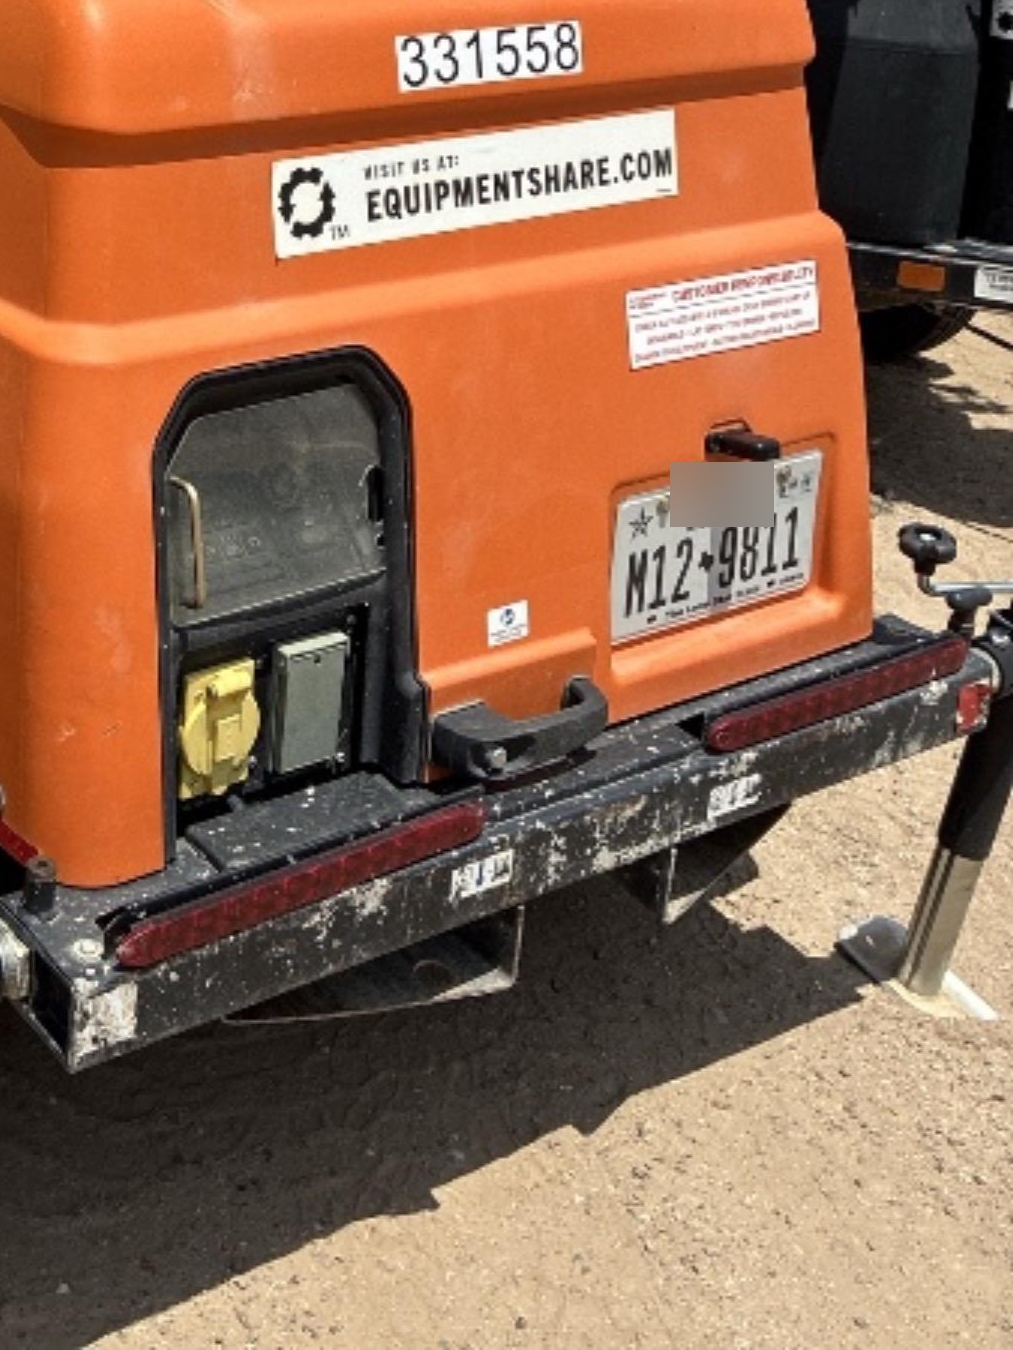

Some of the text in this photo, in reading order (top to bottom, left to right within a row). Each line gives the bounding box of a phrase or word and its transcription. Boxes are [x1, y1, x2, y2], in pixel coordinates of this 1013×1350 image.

[400, 23, 579, 88] 331558
[364, 154, 460, 181] VISIT US AT:
[366, 147, 673, 223] EQUIPMENTSHARE.COM
